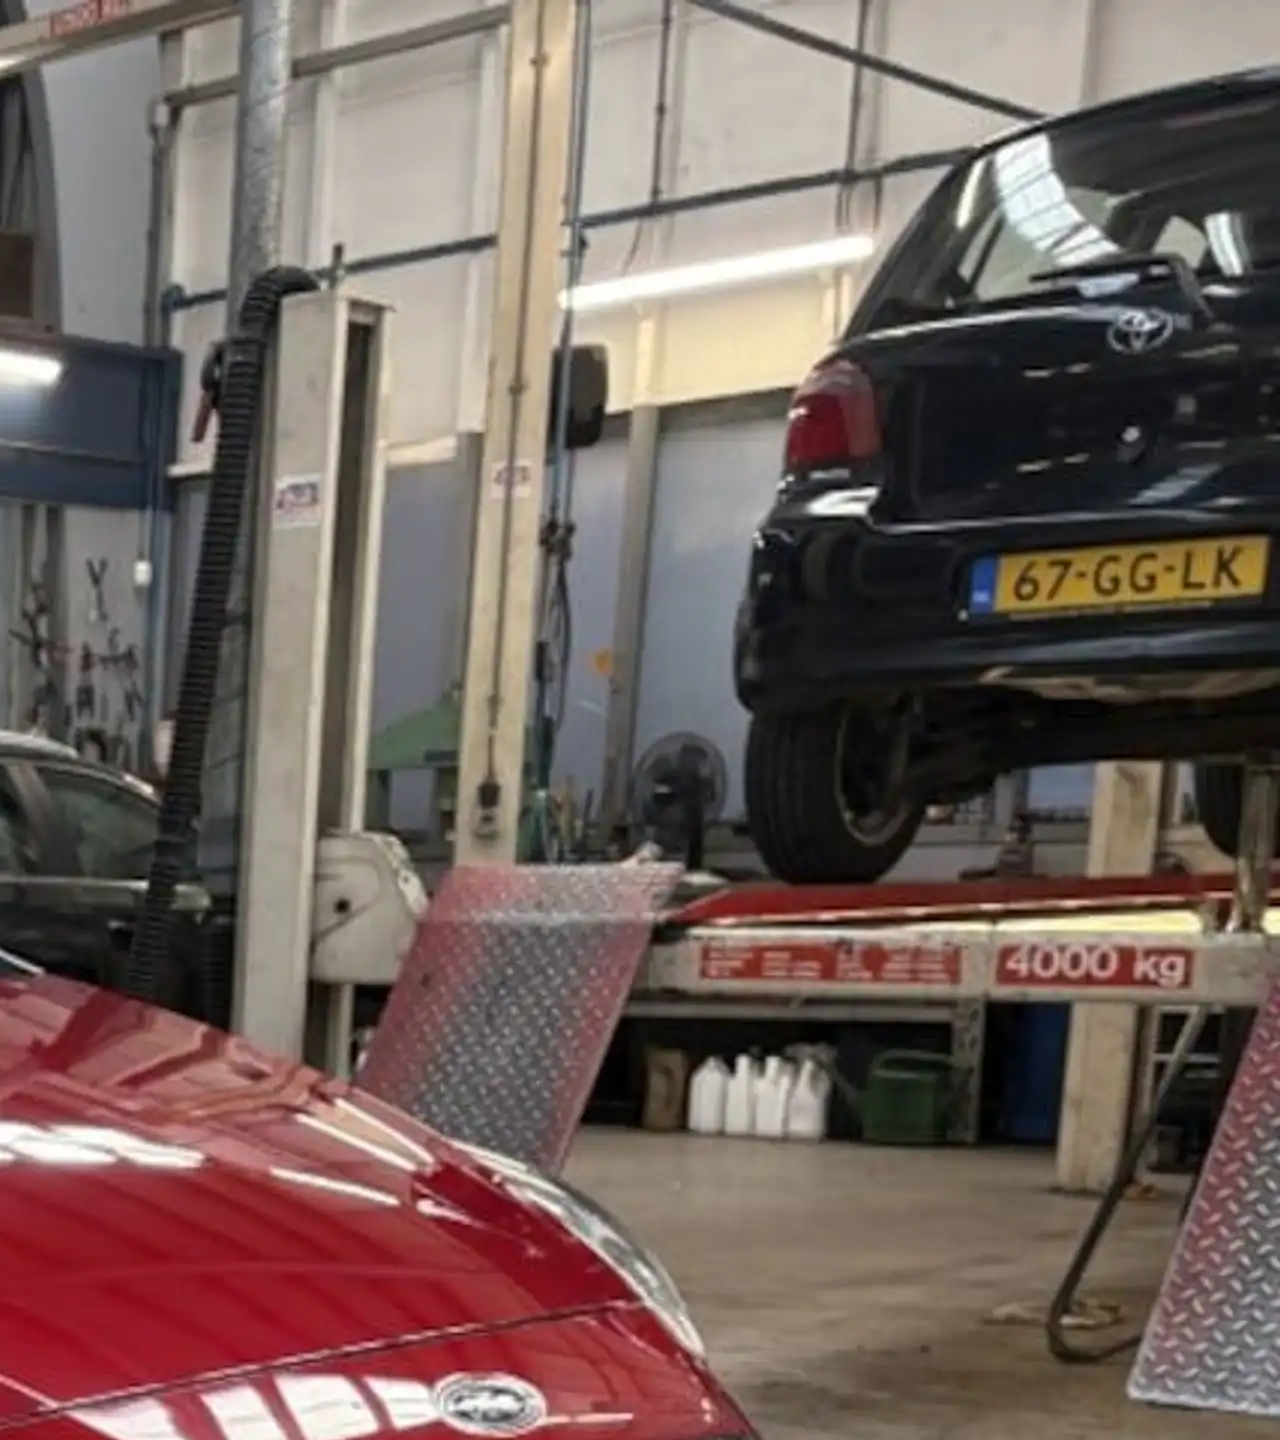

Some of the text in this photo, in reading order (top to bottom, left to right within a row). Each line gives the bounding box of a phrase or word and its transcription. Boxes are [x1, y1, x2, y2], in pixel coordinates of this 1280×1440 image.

[1012, 545, 1245, 602] 67-GG-LK
[1005, 944, 1186, 989] 4000 kg
